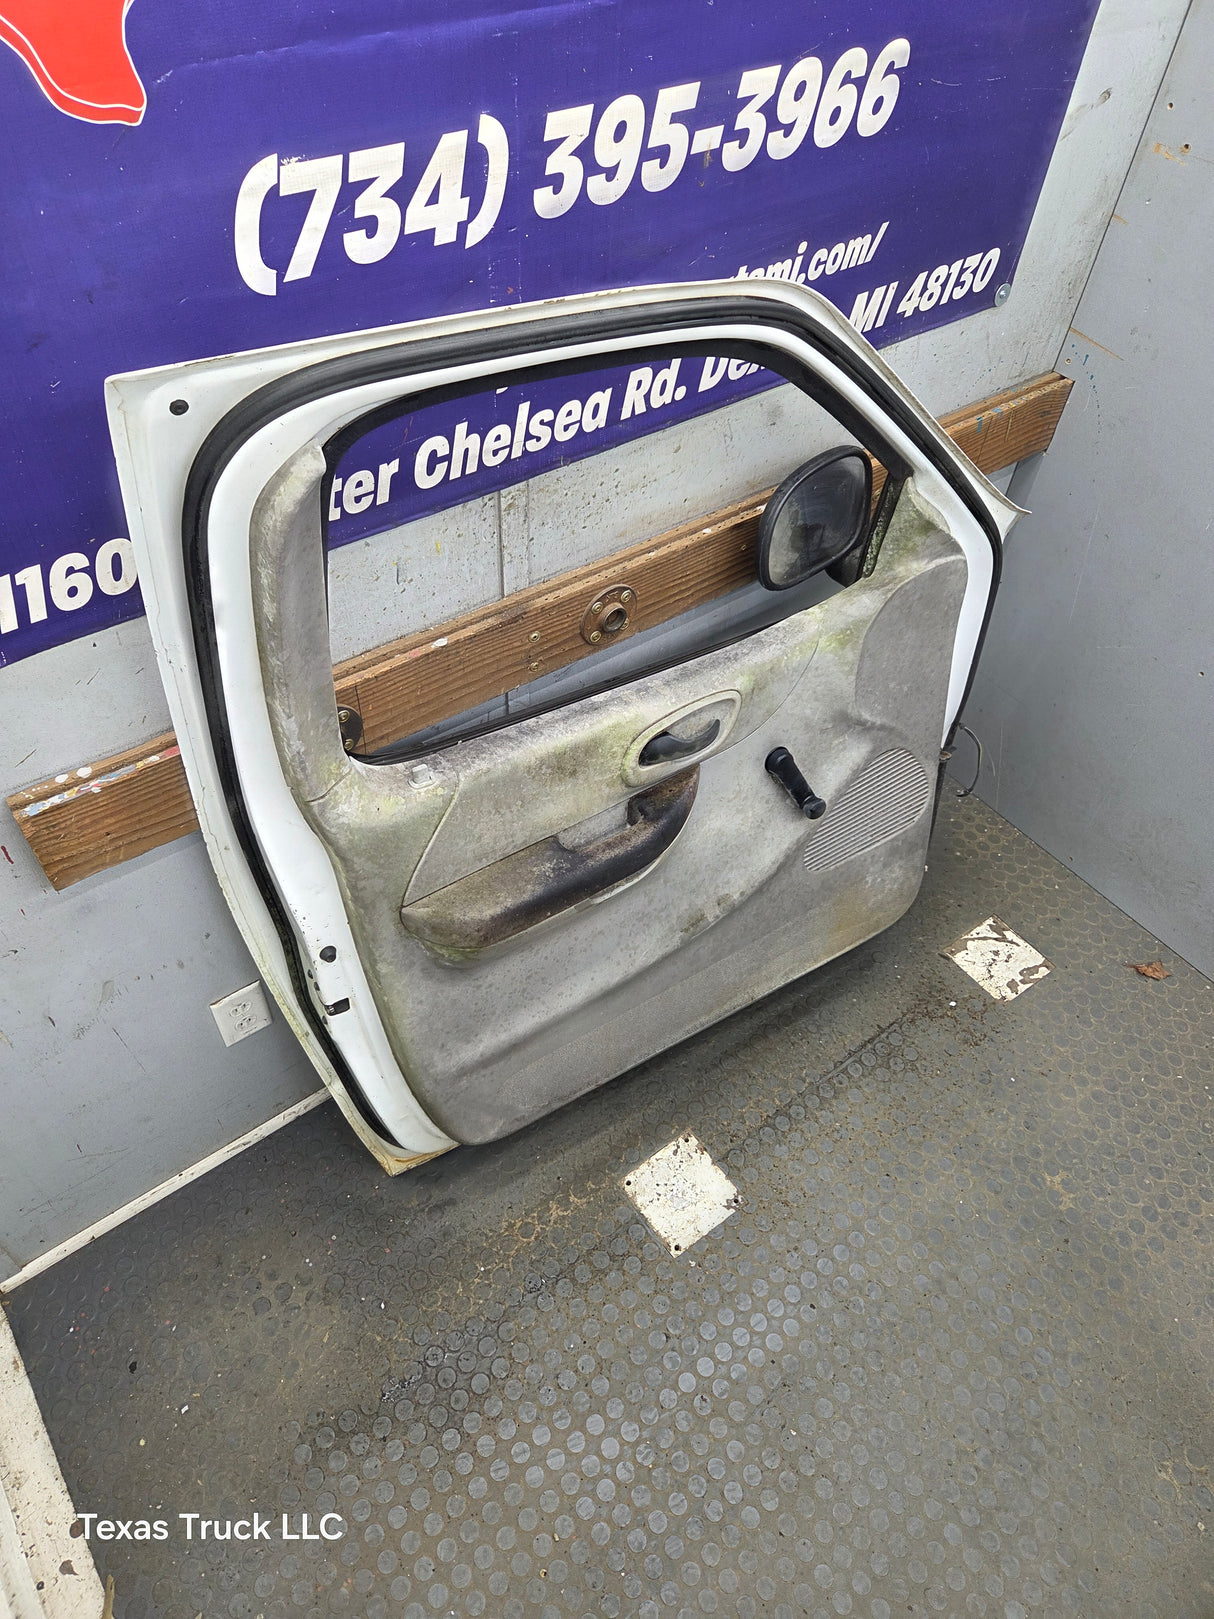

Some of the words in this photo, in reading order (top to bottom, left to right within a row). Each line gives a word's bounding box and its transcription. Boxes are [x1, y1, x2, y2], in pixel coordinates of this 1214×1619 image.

[234, 113, 509, 296] (734)
[533, 38, 911, 220] 395-3966
[0, 538, 138, 634] 1160
[328, 458, 400, 521] ter
[413, 387, 613, 489] Chelsea
[620, 358, 687, 421] Rd.
[850, 280, 900, 333] MI
[896, 247, 1001, 318] 48130
